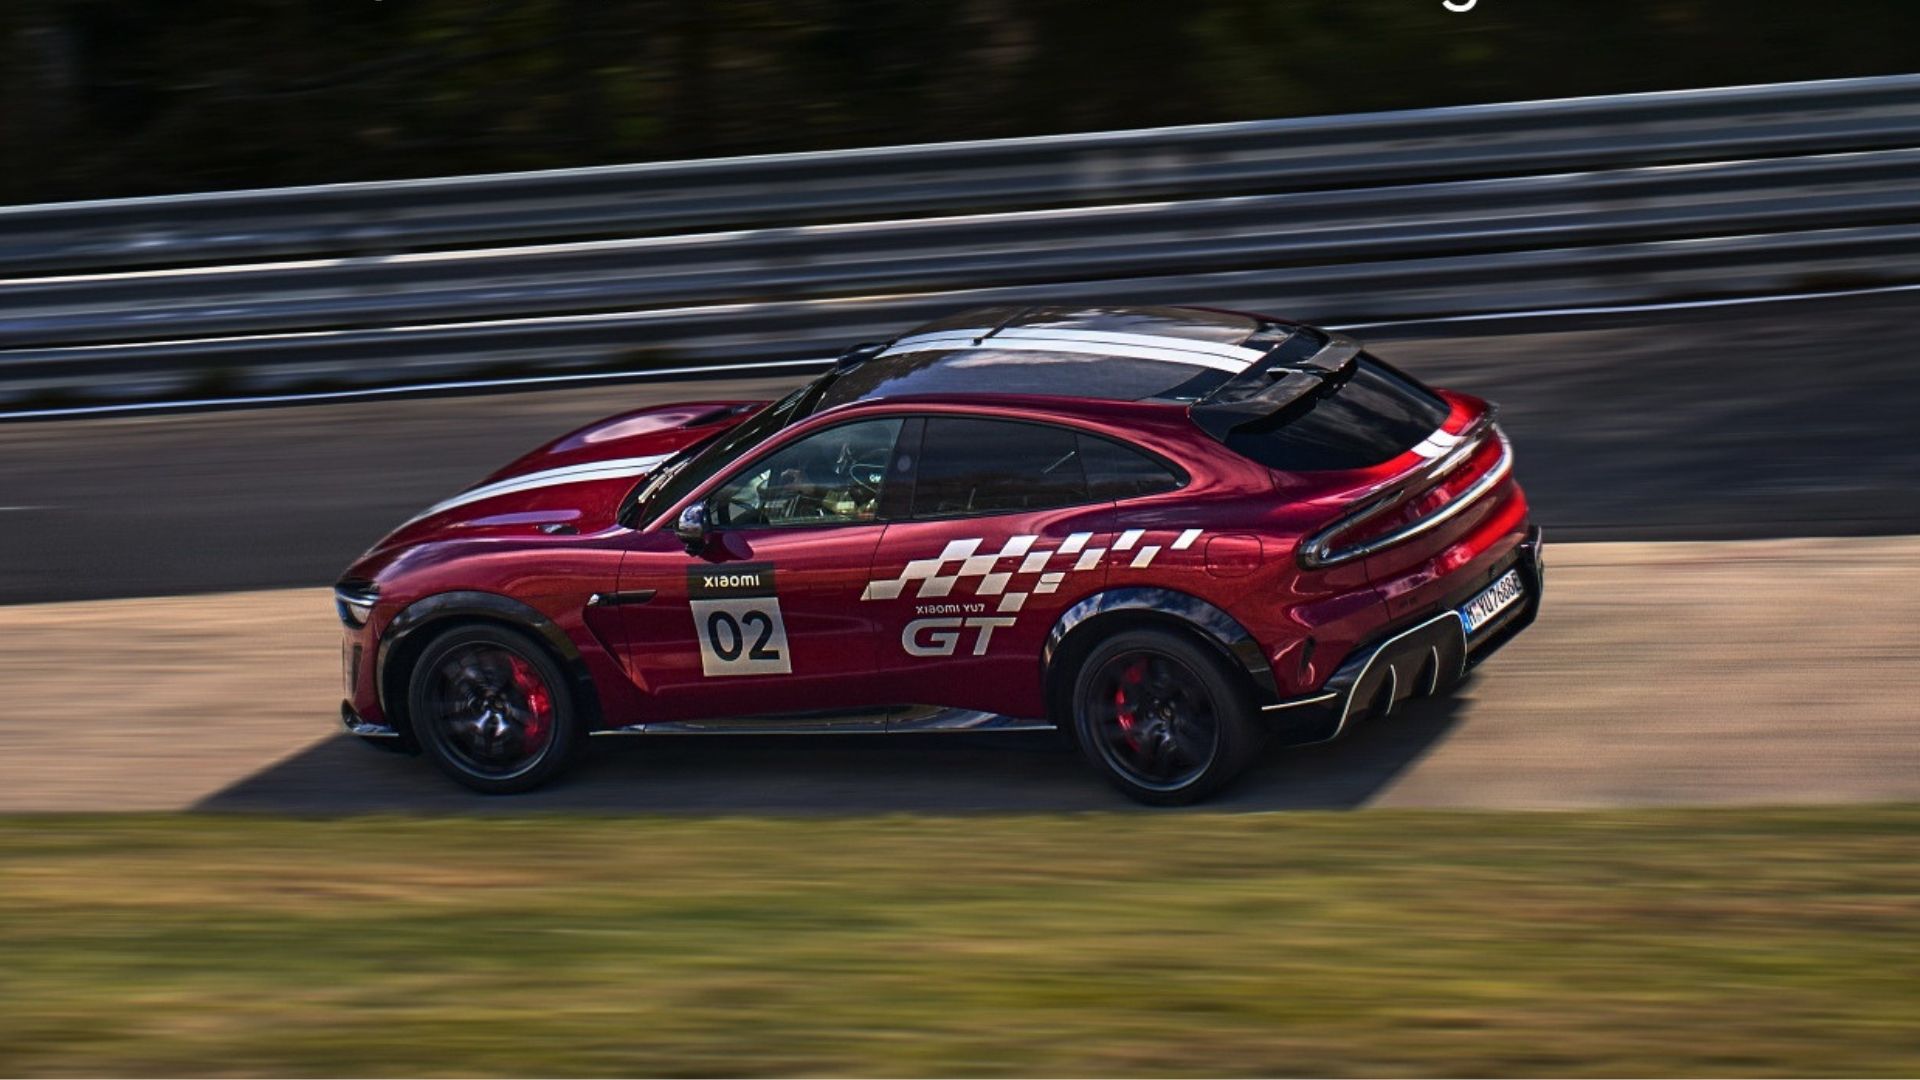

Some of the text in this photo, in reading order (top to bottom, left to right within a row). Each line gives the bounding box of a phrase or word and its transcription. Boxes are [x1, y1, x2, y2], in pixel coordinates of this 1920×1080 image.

[962, 603, 985, 613] YU7
[707, 610, 780, 661] 02
[902, 617, 1017, 656] GT
